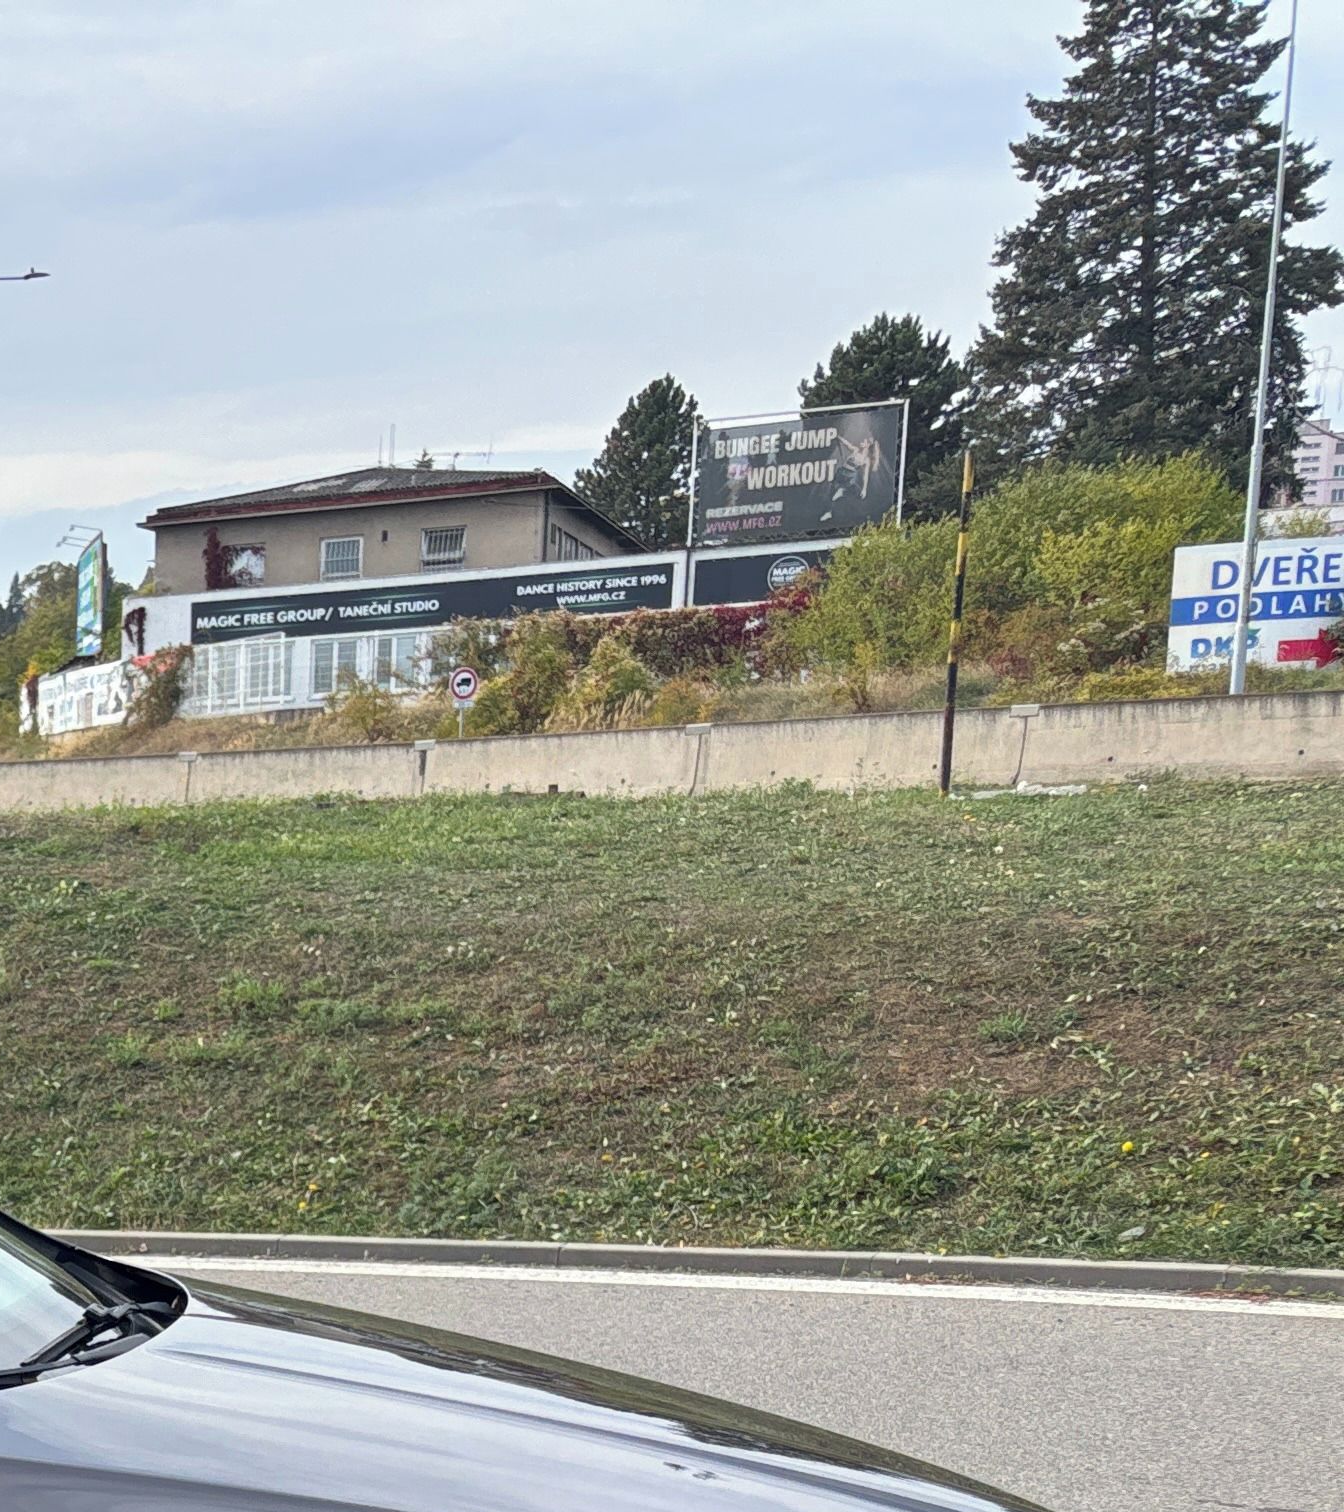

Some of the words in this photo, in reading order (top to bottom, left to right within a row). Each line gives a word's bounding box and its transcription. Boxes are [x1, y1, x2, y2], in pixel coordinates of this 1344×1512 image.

[714, 433, 781, 460] BUNGEE
[785, 428, 838, 452] JUMP
[747, 459, 838, 491] WORKOUT
[705, 501, 784, 518] REZERVACE
[516, 583, 555, 597] DANCE
[557, 579, 604, 593] HISTORY
[605, 576, 638, 588] SINCE
[640, 574, 667, 586] 1996
[196, 614, 241, 629] MAGIC
[243, 612, 274, 625] FREE
[276, 606, 334, 624] GROUP/
[337, 600, 393, 618] TANEČNÍ
[394, 599, 440, 614] STUDIO
